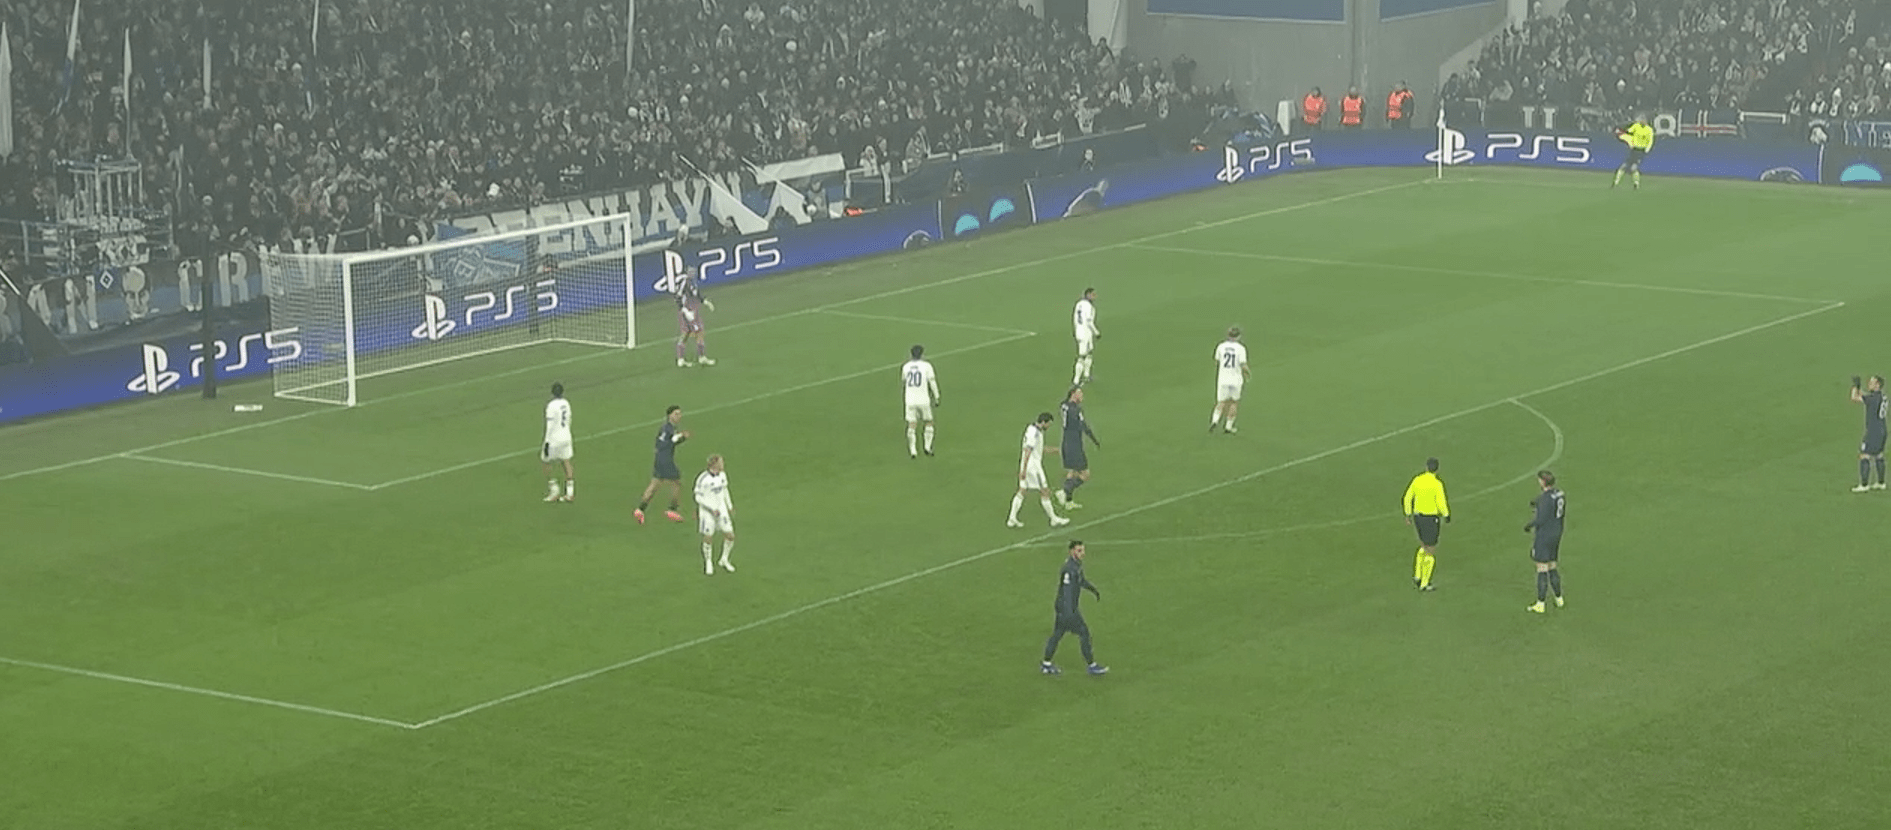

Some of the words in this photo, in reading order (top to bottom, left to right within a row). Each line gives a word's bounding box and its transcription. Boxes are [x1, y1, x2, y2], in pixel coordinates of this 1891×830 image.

[1249, 138, 1313, 173] PS5
[1486, 133, 1591, 163] PS5
[698, 237, 781, 280] PS5
[464, 279, 558, 326] PS5
[189, 326, 302, 378] PS5
[1223, 352, 1236, 368] 21
[907, 371, 922, 387] 20
